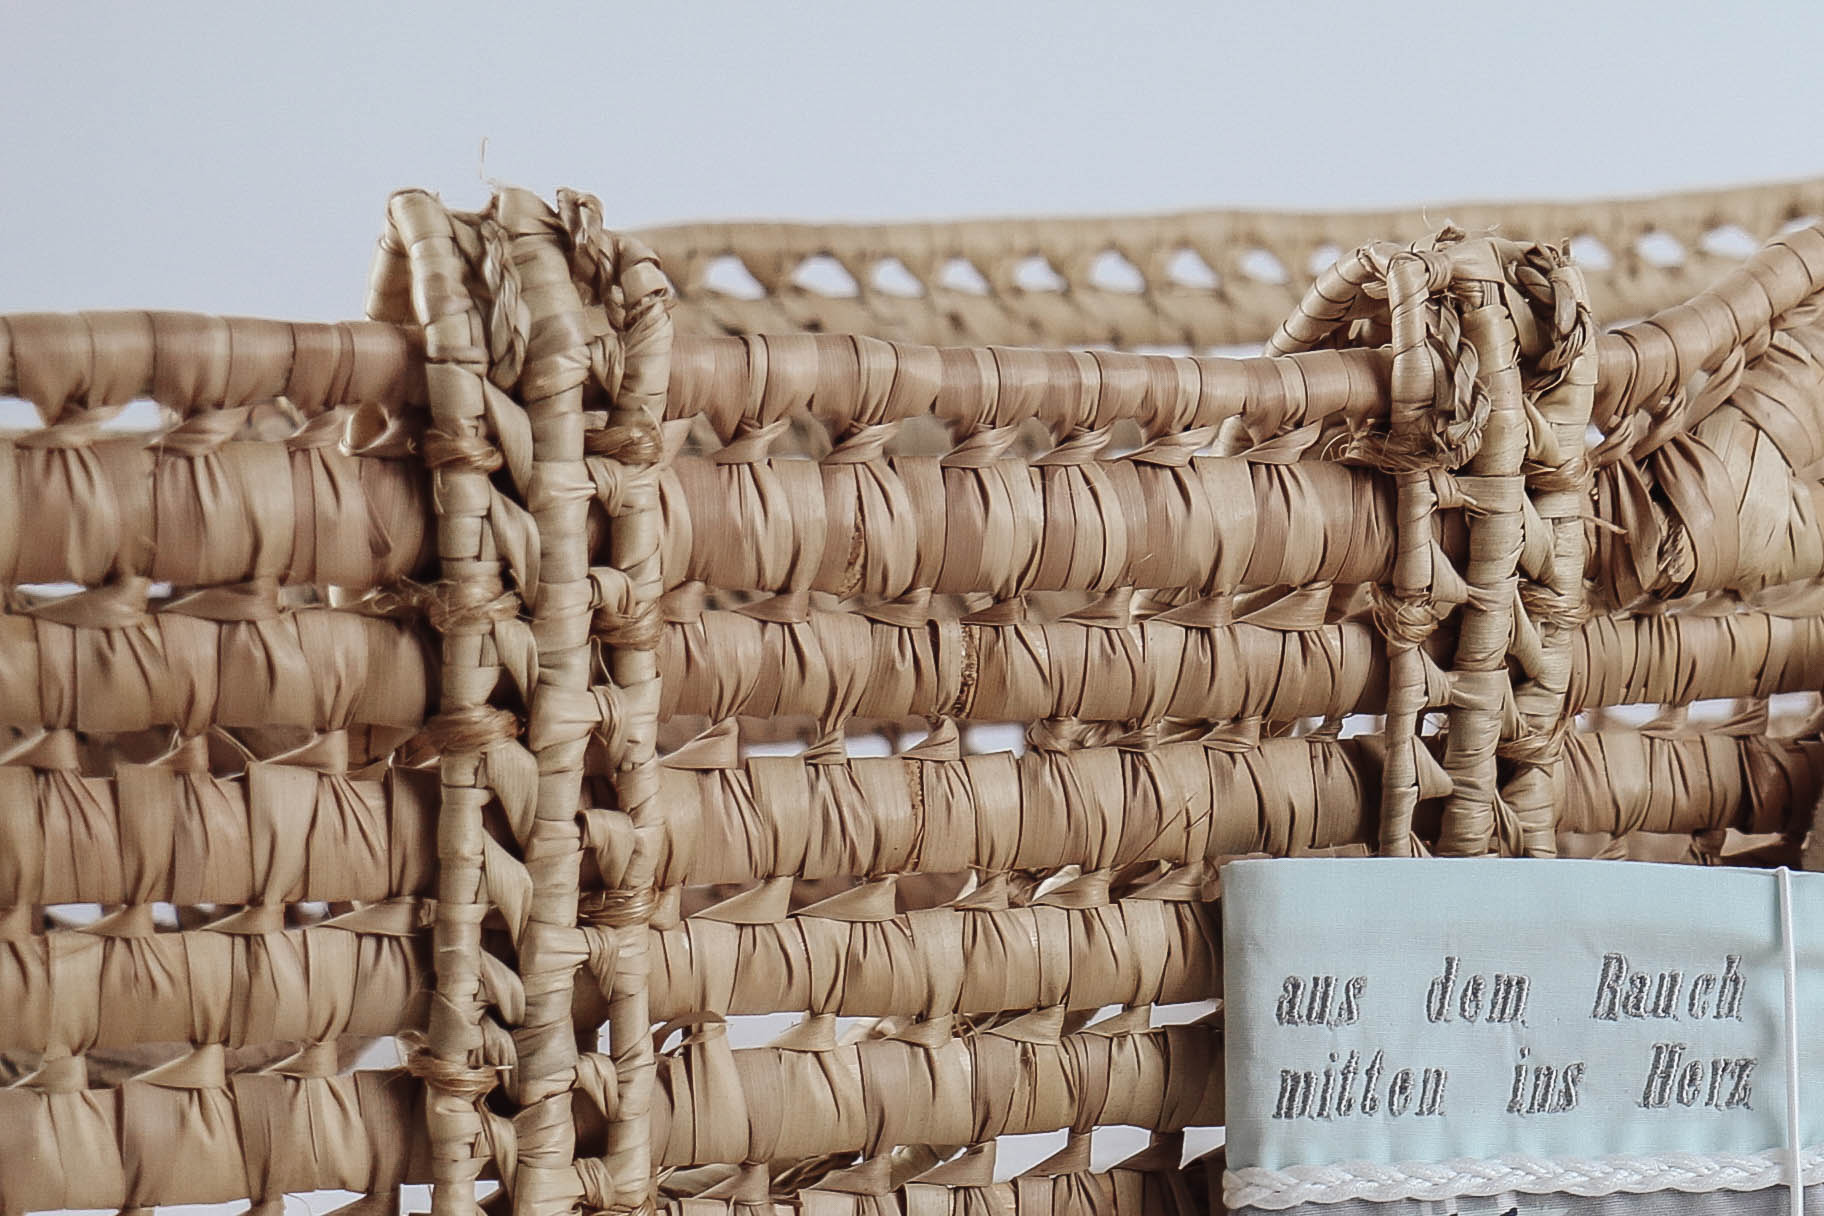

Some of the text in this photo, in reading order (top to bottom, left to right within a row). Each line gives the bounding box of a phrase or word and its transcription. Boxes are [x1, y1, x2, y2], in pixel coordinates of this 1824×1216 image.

[1273, 974, 1367, 1028] aus
[1426, 955, 1530, 1029] dem
[1273, 1041, 1757, 1120] mitten ins Herz
